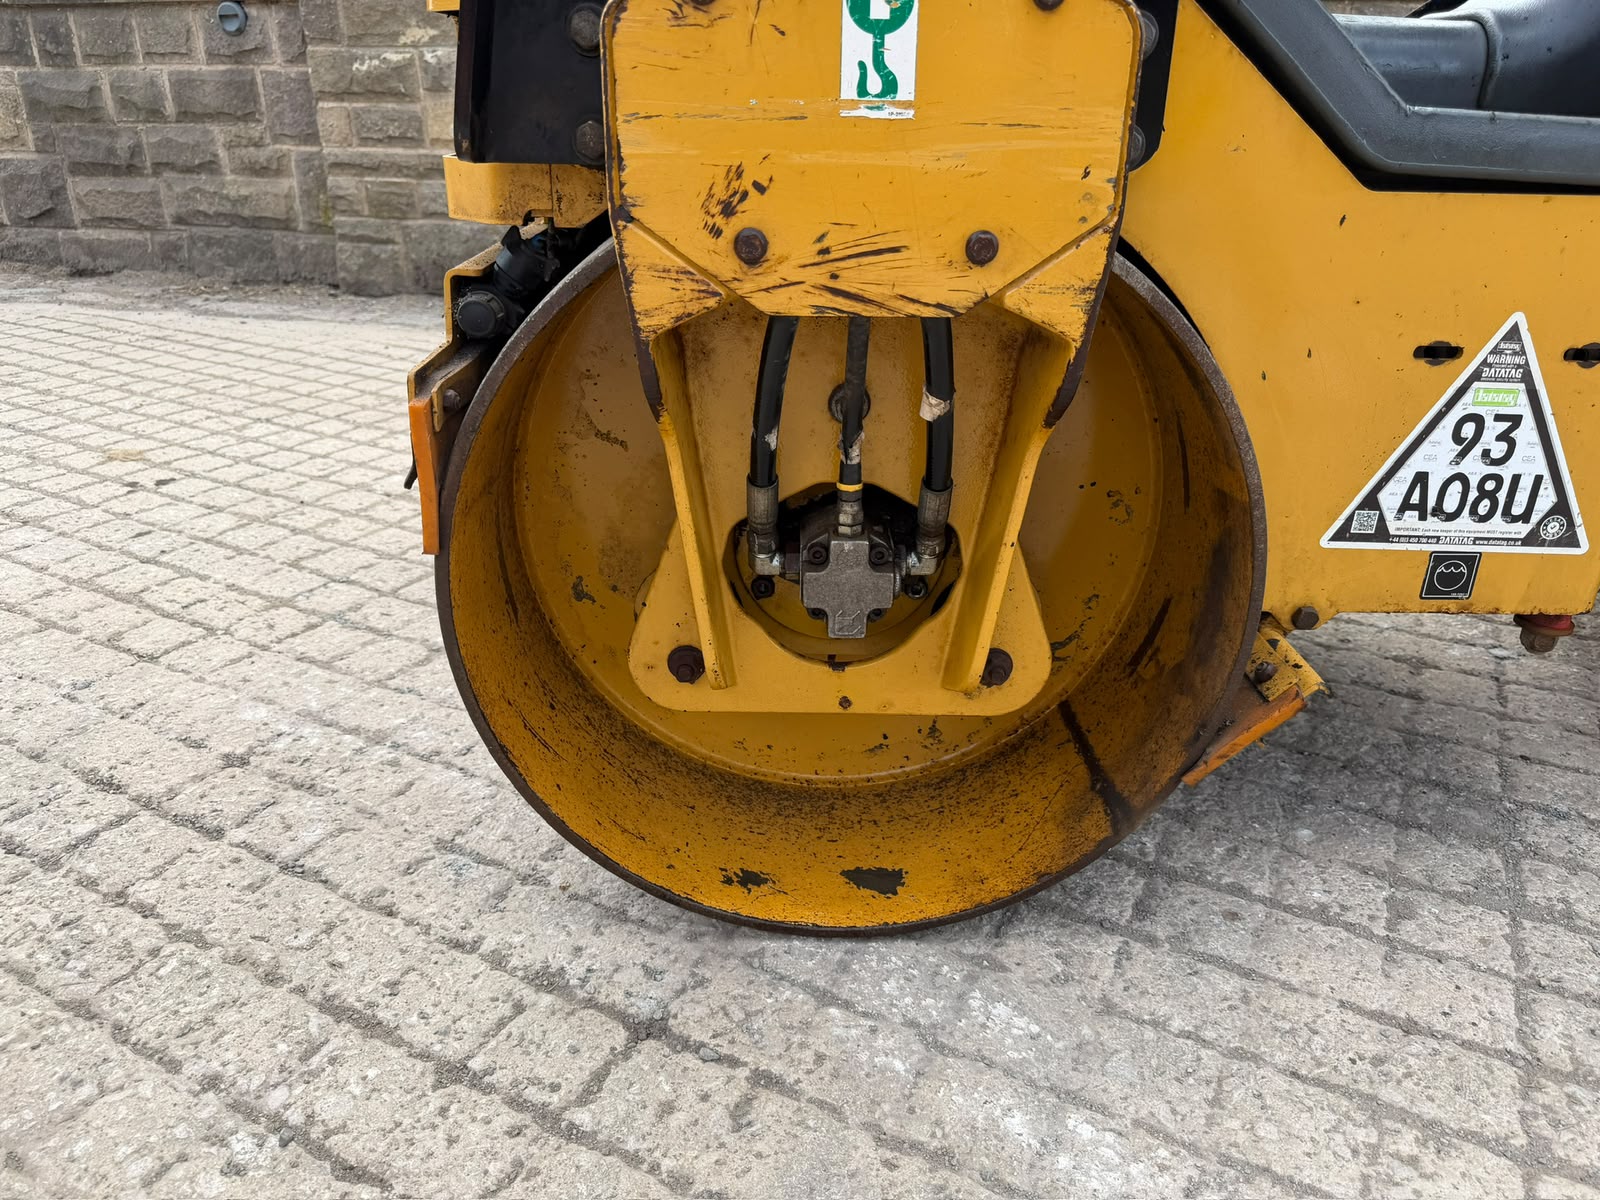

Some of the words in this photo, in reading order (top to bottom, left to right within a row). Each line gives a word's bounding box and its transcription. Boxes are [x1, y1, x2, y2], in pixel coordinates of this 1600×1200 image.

[1487, 354, 1526, 365] WARNING
[1481, 367, 1523, 378] DATATAG
[1449, 413, 1523, 466] 93
[1439, 537, 1474, 545] DATATAG
